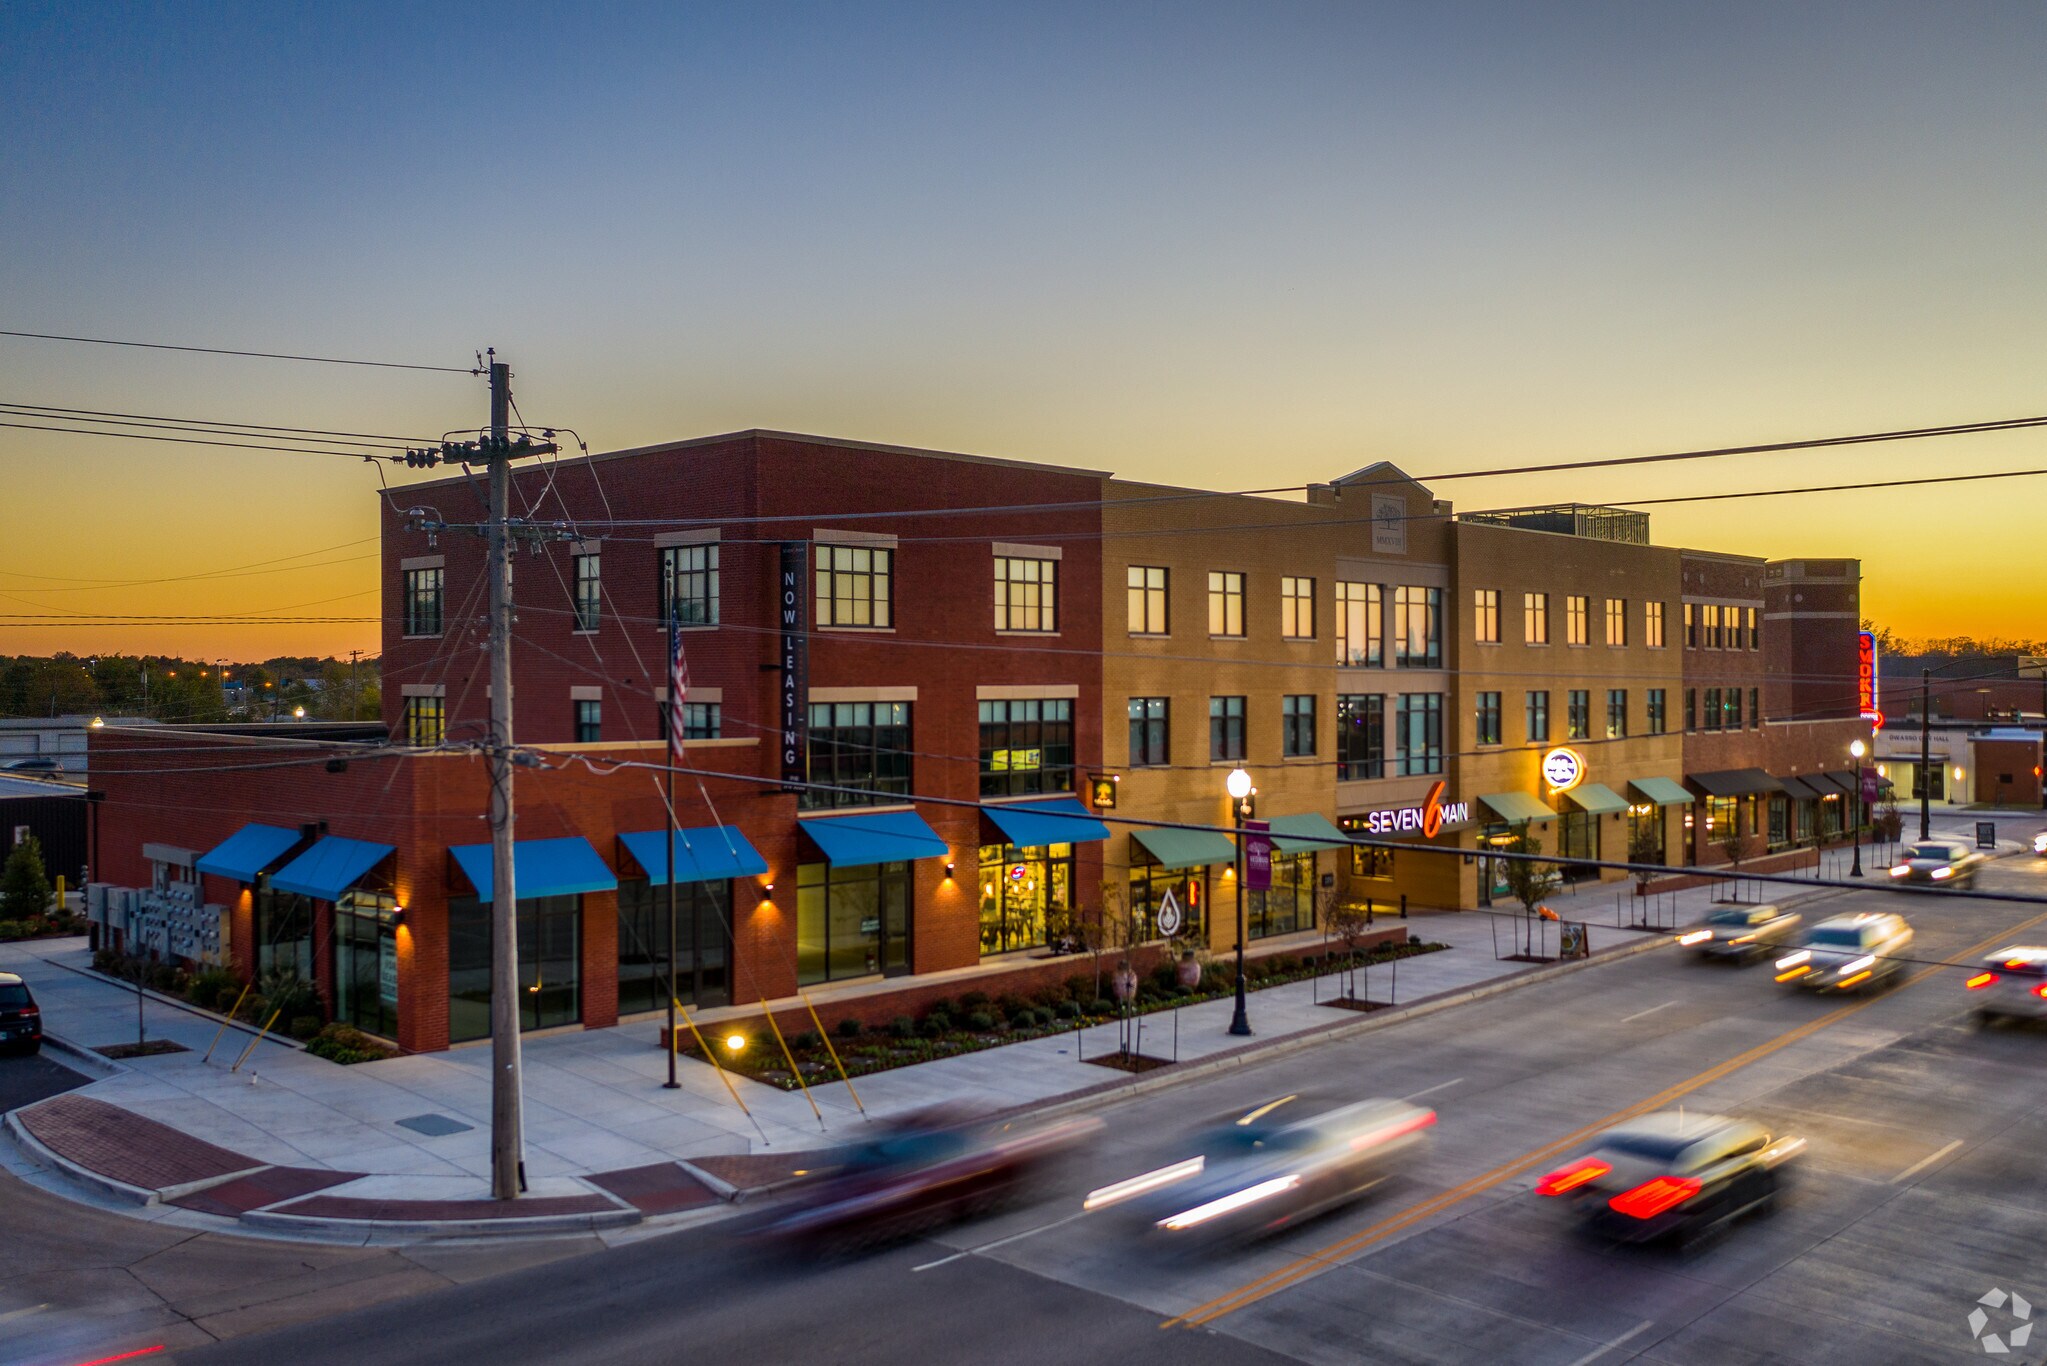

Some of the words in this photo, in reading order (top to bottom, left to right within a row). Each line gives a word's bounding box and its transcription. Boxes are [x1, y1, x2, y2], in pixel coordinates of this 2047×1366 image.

[784, 572, 796, 624] NOW
[784, 636, 796, 765] LEASING
[1368, 807, 1424, 834] SEVEN
[1423, 780, 1446, 839] 6
[1439, 801, 1469, 826] MAIN
